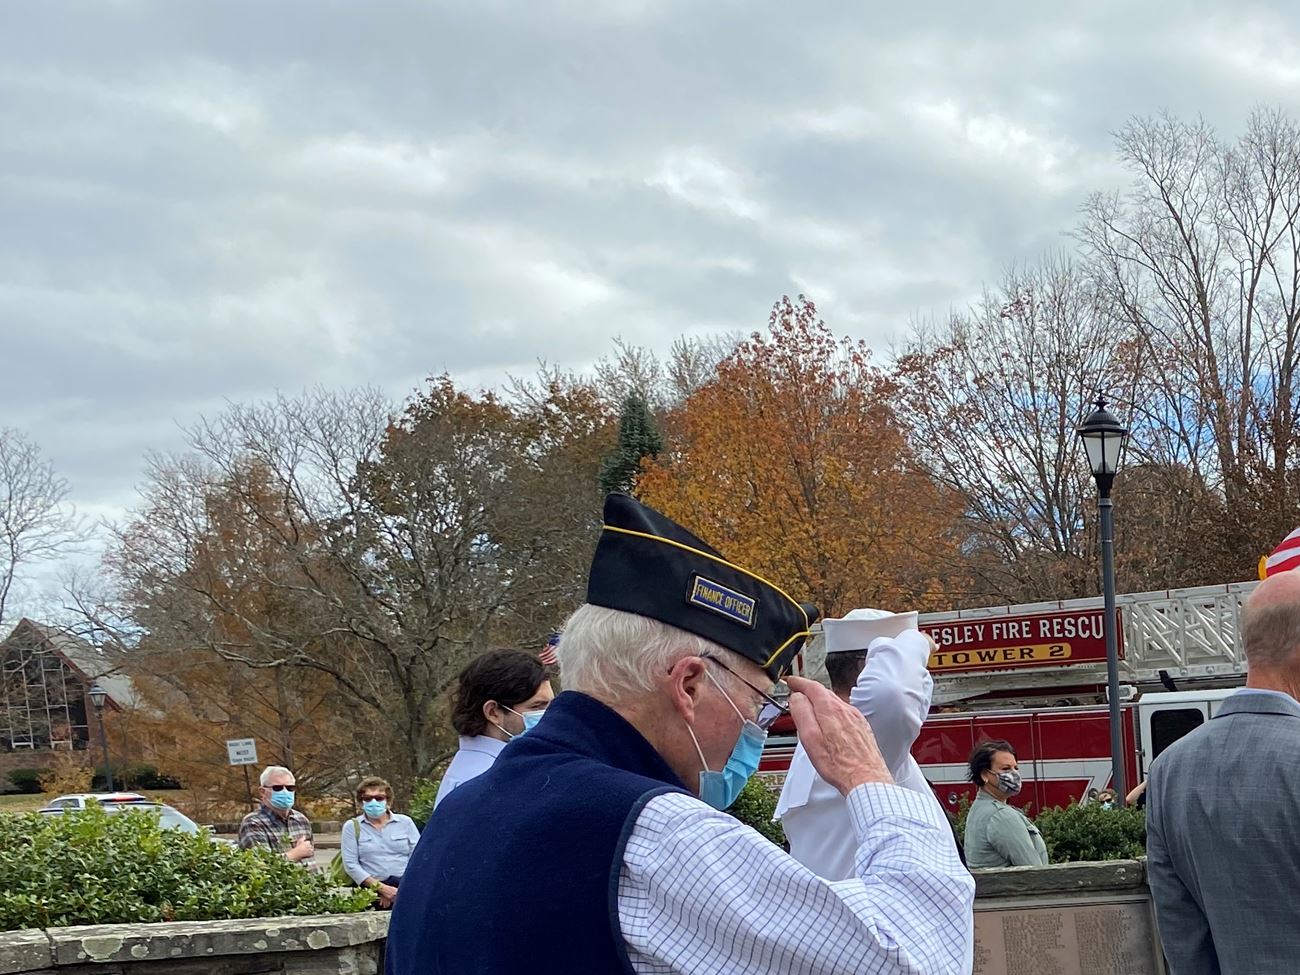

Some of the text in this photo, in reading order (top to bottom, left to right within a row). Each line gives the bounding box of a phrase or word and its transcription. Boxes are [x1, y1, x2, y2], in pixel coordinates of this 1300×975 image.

[697, 584, 751, 617] FINANCE OFFICER
[922, 615, 1104, 646] ESLEY FIRE RESCU
[933, 645, 1065, 665] TOWER 2
